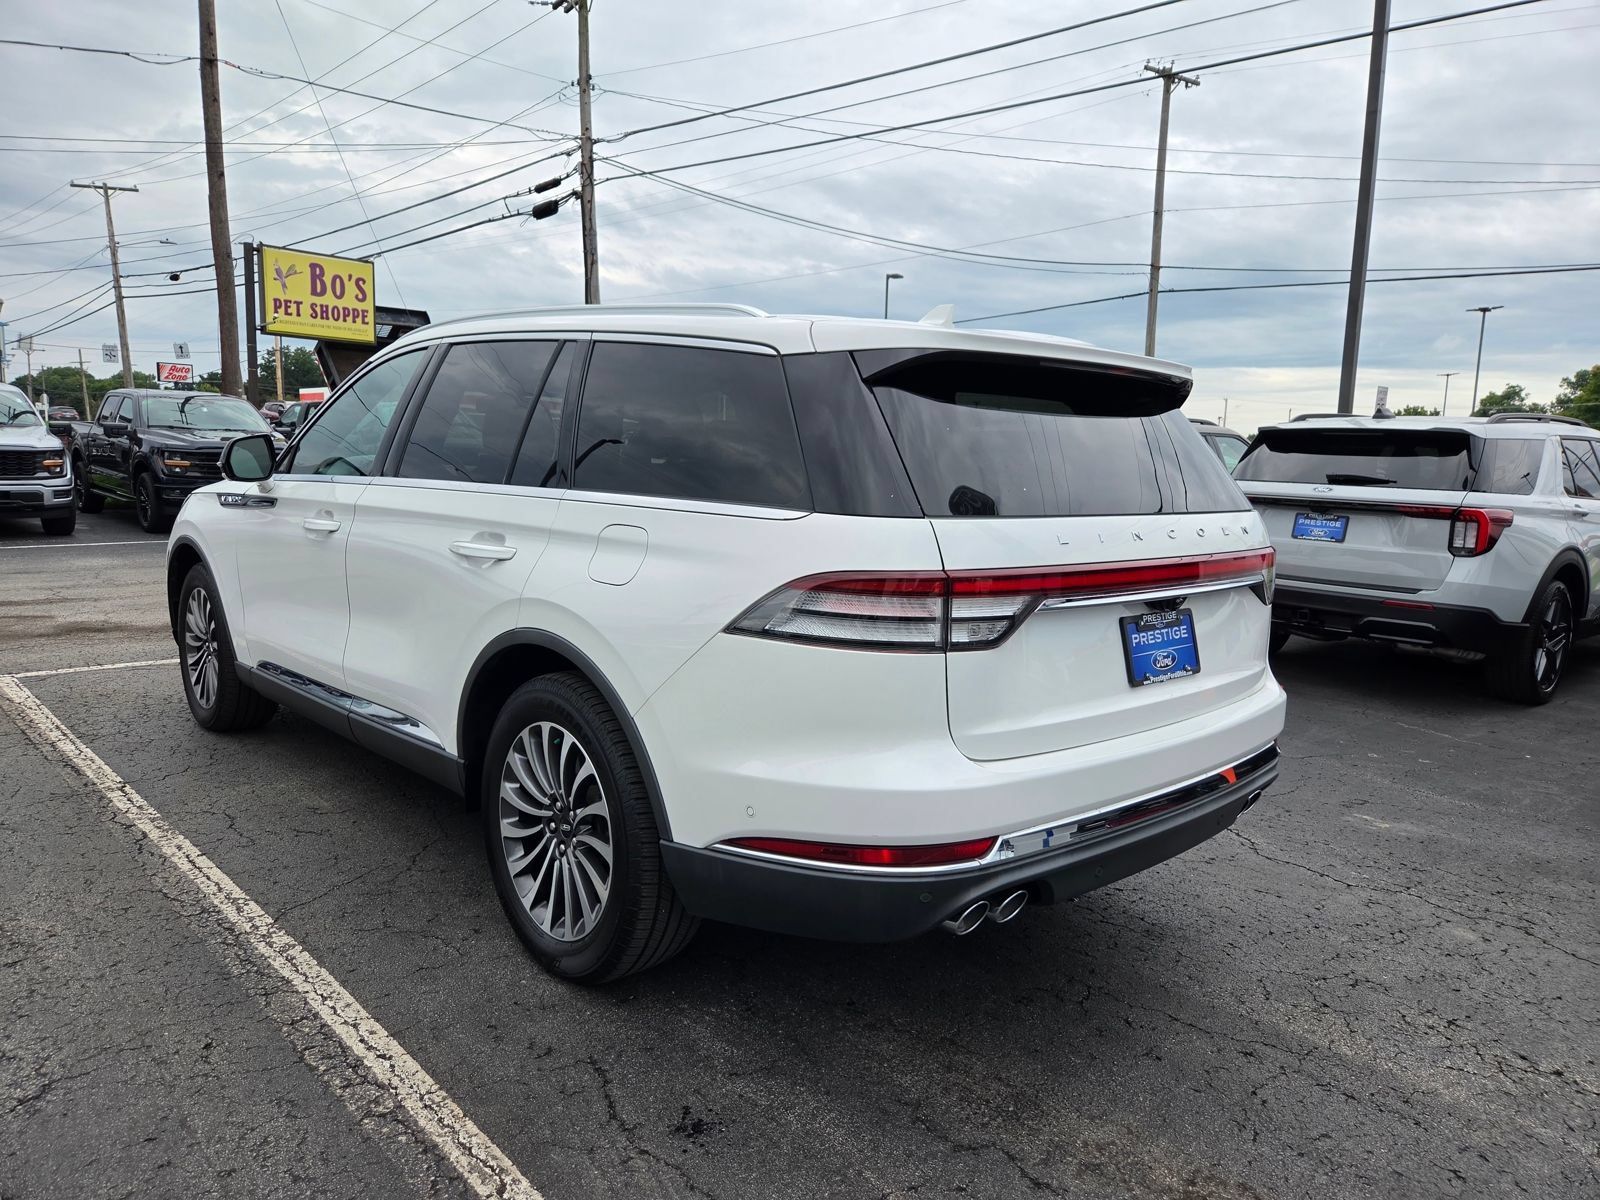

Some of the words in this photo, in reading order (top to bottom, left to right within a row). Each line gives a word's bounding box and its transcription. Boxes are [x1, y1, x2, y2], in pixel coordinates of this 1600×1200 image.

[273, 297, 303, 317] PET
[310, 303, 369, 325] SHOPPE
[169, 365, 190, 373] Auto
[164, 372, 188, 380] Zone
[1299, 519, 1341, 527] PRESTIGE
[1057, 526, 1249, 545] LINCOLN
[1142, 611, 1177, 622] PRESTIGE
[1132, 626, 1188, 647] PRESTIGE
[1155, 652, 1173, 667] Ford
